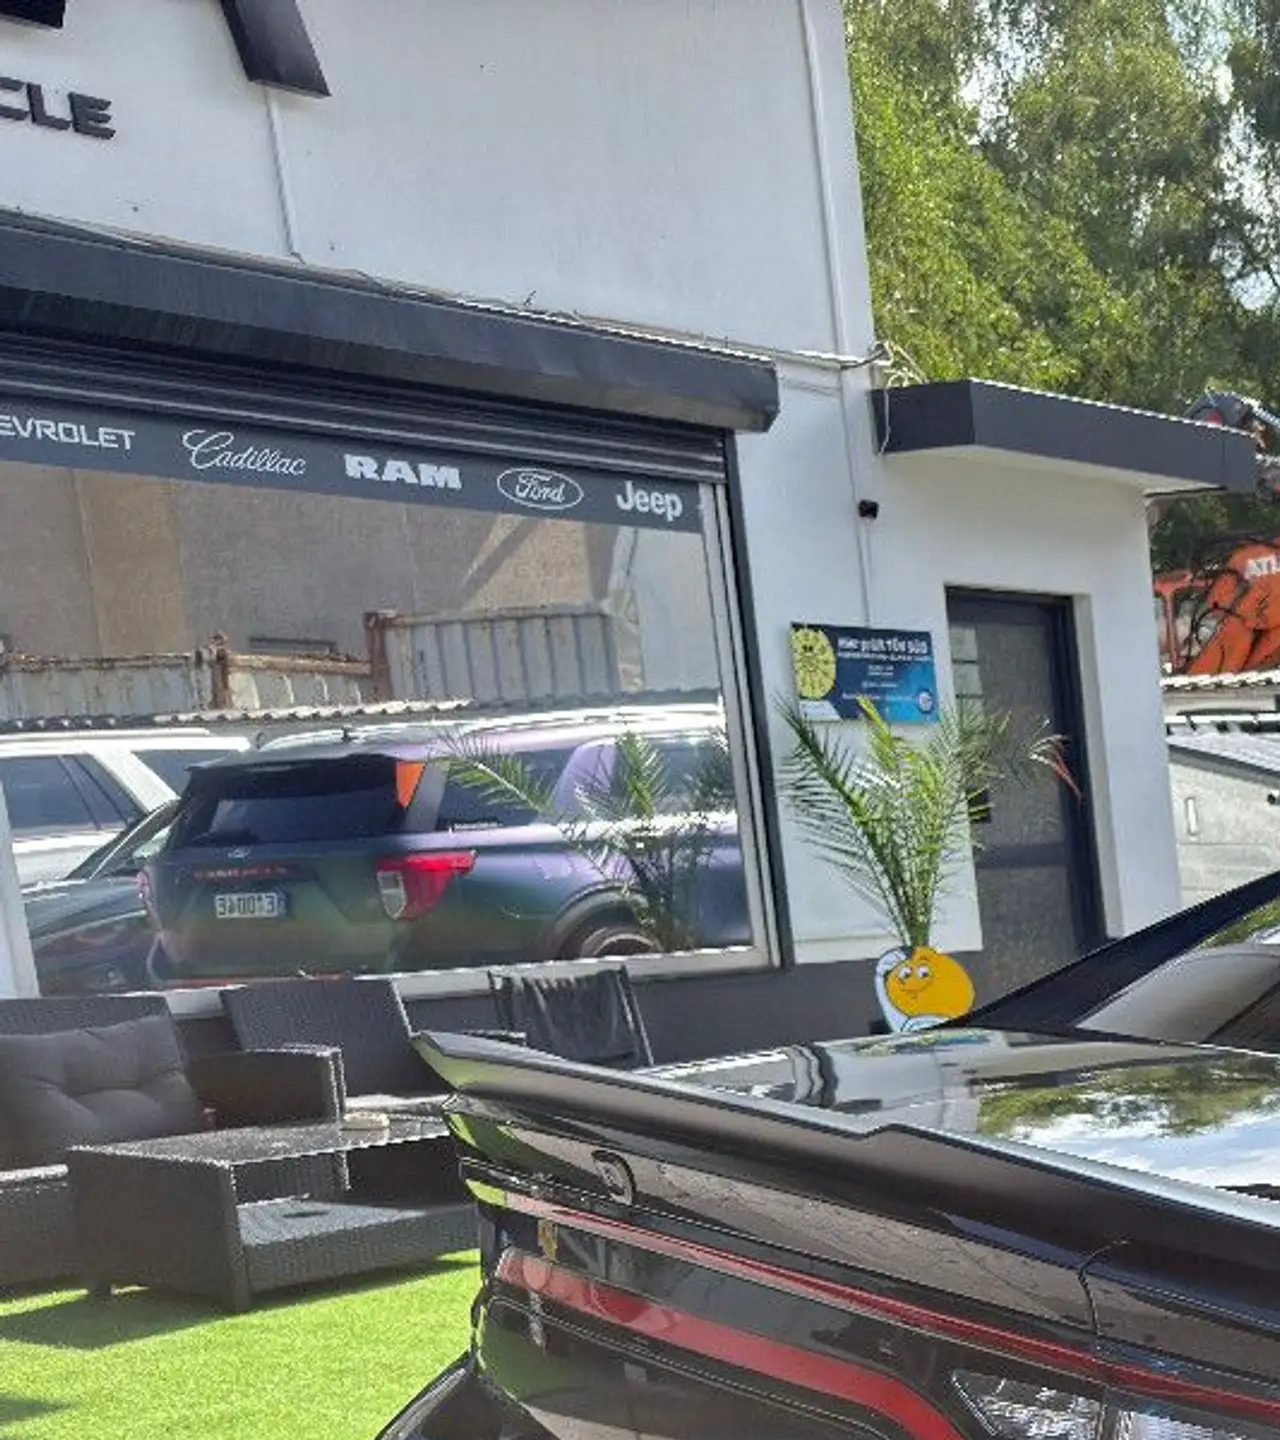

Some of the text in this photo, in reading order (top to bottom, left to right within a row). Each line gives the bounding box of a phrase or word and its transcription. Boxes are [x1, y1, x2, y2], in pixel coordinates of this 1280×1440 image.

[182, 429, 306, 475] Cadillac
[344, 454, 462, 490] RAM
[515, 473, 566, 503] Ford
[616, 480, 684, 522] Jeep
